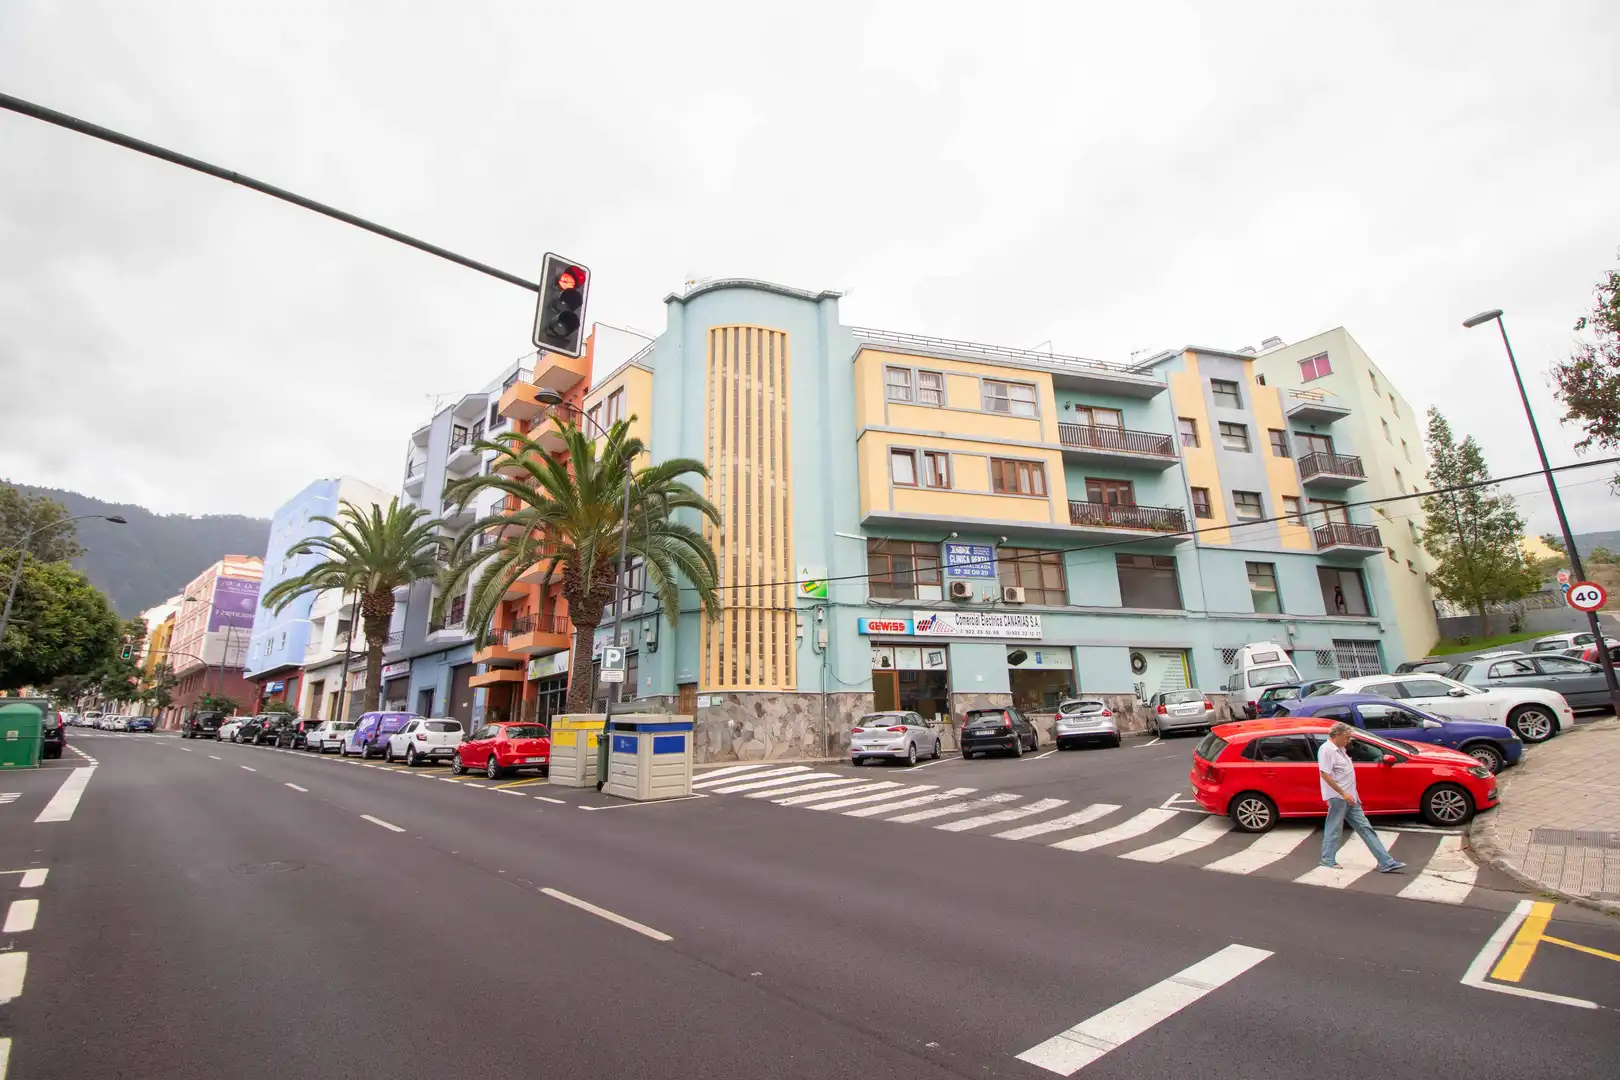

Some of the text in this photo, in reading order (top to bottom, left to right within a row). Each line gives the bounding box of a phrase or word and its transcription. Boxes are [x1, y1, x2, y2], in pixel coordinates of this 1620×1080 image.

[1575, 590, 1599, 602] 40
[955, 613, 980, 626] Comercial
[1003, 614, 1029, 628] CANARIAS
[605, 649, 621, 668] P
